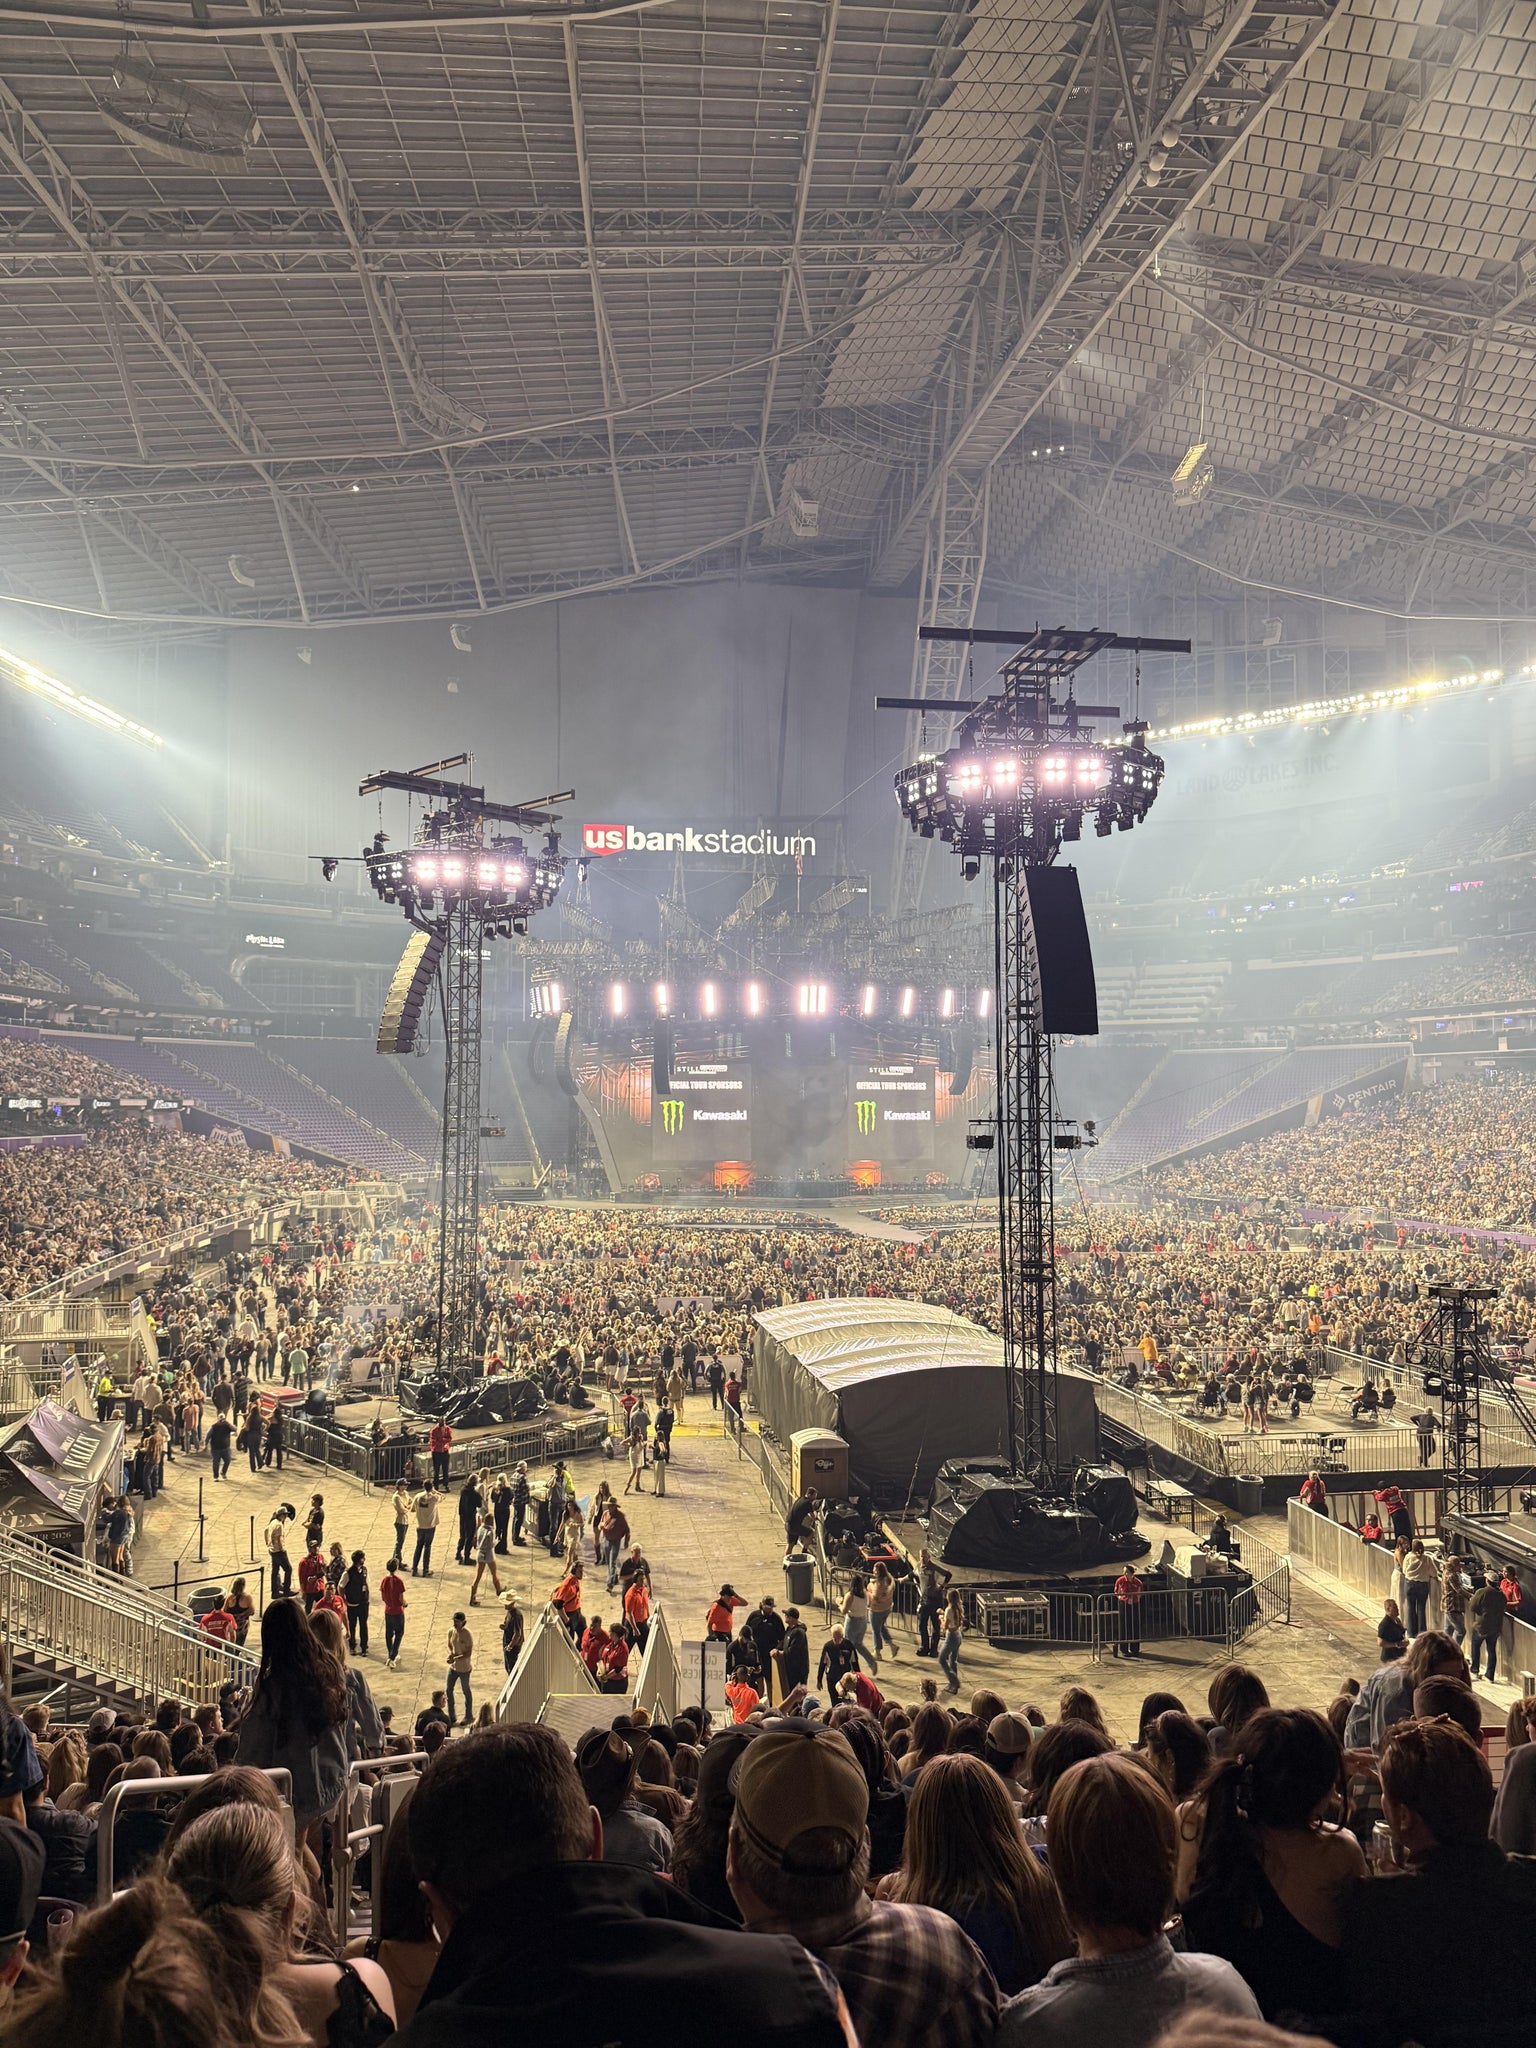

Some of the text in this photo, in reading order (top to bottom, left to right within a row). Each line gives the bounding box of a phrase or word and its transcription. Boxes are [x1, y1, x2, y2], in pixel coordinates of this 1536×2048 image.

[669, 1080, 743, 1090] FICIAL TOUR SPONSORS
[856, 1081, 927, 1091] OFFICIAL TOUR SPONSORS
[1347, 1079, 1397, 1103] PENTAIR
[693, 1109, 748, 1121] Kawasaki
[883, 1110, 931, 1121] Kawasaki
[51, 1531, 72, 1540] 2026
